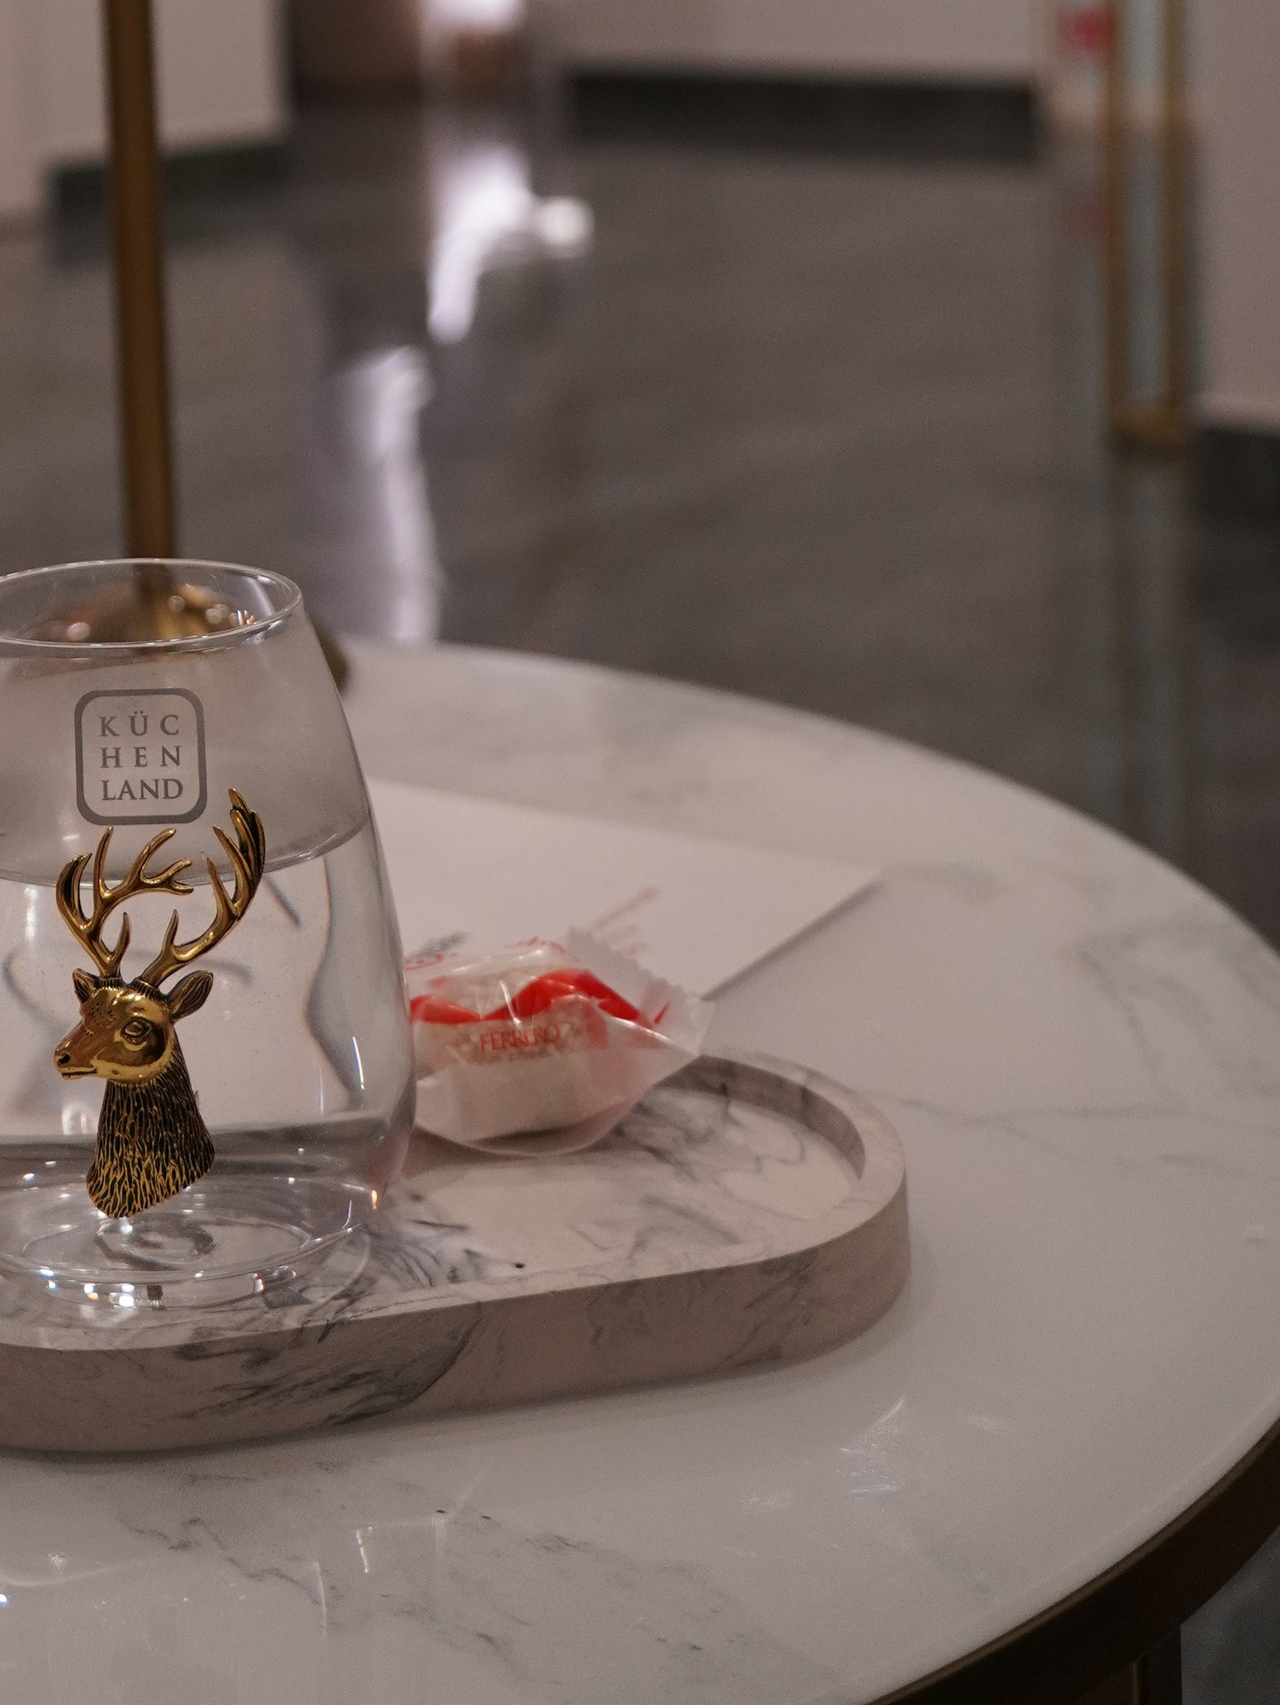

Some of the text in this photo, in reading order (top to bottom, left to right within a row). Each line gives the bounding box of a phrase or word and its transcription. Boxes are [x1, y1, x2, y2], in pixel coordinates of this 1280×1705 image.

[99, 711, 180, 737] KÜC
[100, 745, 182, 768] HEN
[101, 778, 184, 801] LAND
